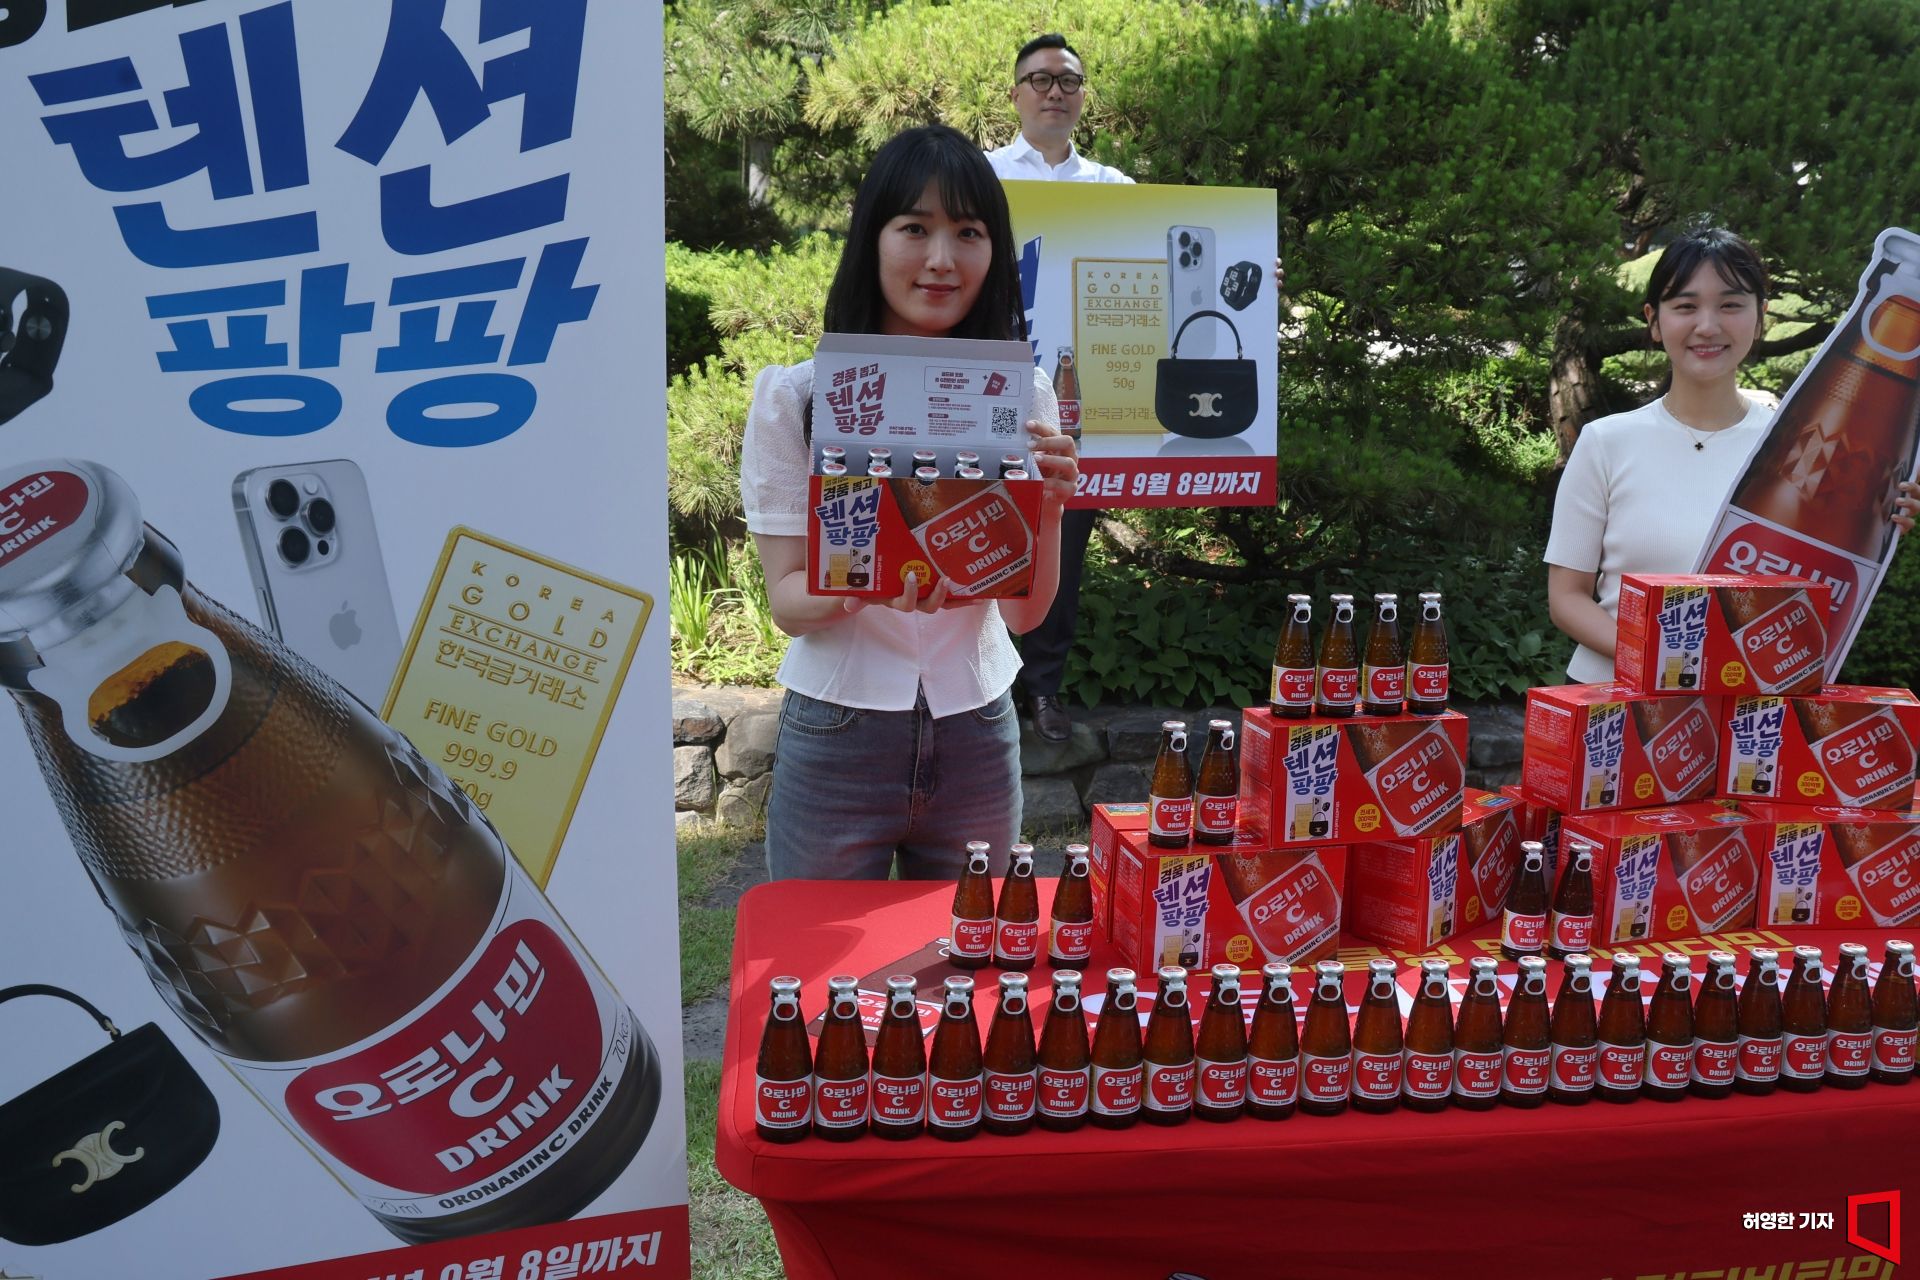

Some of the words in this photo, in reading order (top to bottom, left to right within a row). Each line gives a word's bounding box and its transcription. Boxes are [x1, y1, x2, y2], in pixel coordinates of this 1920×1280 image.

[28, 0, 588, 269] 텐션
[1087, 272, 1159, 280] KOREA
[1087, 283, 1159, 294] GOLD
[1088, 300, 1159, 309] EXCHANGE
[1086, 314, 1160, 327] 한국금거래소
[145, 236, 601, 448] 팡팡
[1091, 344, 1117, 355] FINE
[1121, 344, 1156, 356] GOLD
[832, 367, 856, 387] 경품
[1106, 361, 1142, 373] 999.9
[825, 372, 887, 414] 텐션
[1112, 377, 1135, 390] 50g
[835, 410, 885, 435] 팡팡
[824, 482, 849, 502] 경품
[1132, 472, 1171, 496] 9월
[1176, 471, 1261, 495] 8일까지
[816, 487, 880, 528] 텐션
[826, 524, 880, 547] 팡팡
[931, 500, 1006, 551] 오로나민
[0, 516, 58, 558] RINK
[968, 532, 990, 553] C
[965, 544, 1012, 575] DRINK
[472, 560, 614, 623] KOREA
[462, 584, 607, 649] GOLD
[1658, 596, 1708, 633] 텐션
[1665, 628, 1706, 650] 팡팡
[1747, 606, 1808, 653] 오로나민
[450, 612, 599, 677] EXCHANGE
[1776, 635, 1794, 654] C
[1773, 646, 1811, 675] DRINK
[435, 639, 587, 710] 한국금거래소
[1430, 679, 1439, 687] C
[424, 698, 481, 734] FINE
[487, 720, 558, 757] GOLD
[1584, 712, 1625, 752] 텐션
[1731, 706, 1784, 739] 텐션
[1290, 731, 1312, 751] 경품
[1656, 714, 1703, 764] 오로나민
[1737, 737, 1782, 757] 팡팡
[1826, 722, 1894, 766] 오로나민
[442, 740, 518, 781] 999.9
[1284, 734, 1338, 778] 텐션
[1589, 744, 1624, 768] 팡팡
[1679, 742, 1692, 762] C
[1858, 750, 1879, 769] C
[1381, 739, 1443, 793] 오로나민
[1676, 752, 1707, 782] DRINK
[1855, 762, 1898, 789] DRINK
[1293, 770, 1337, 795] 팡팡
[1412, 771, 1431, 792] C
[1410, 781, 1449, 815] DRINK
[1218, 811, 1226, 819] C
[1770, 833, 1822, 869] 텐션
[1161, 863, 1184, 884] 경품
[1616, 844, 1659, 885] 텐션
[1690, 844, 1742, 895] 오로나민
[1777, 863, 1821, 886] 팡팡
[1154, 867, 1209, 910] 텐션
[1620, 876, 1656, 901] 팡팡
[1714, 873, 1730, 893] C
[1893, 869, 1911, 888] C
[1254, 870, 1319, 924] 오로나민
[1711, 882, 1744, 914] DRINK
[1161, 902, 1208, 928] 팡팡
[1286, 902, 1305, 923] C
[960, 925, 992, 935] 오로나민
[972, 935, 981, 943] C
[1284, 912, 1325, 945] DRINK
[1017, 937, 1027, 945] C
[315, 939, 545, 1121] 오로나민
[1411, 1059, 1450, 1071] 오로나민
[1851, 1050, 1862, 1060] C
[1255, 1065, 1295, 1077] 오로나민
[1426, 1071, 1437, 1081] C
[1614, 1073, 1636, 1081] DRINK
[1621, 1063, 1632, 1073] C
[448, 1057, 514, 1118] C
[762, 1085, 806, 1099] 오로나민
[823, 1084, 865, 1099] 오로나민
[877, 1082, 920, 1095] 오로나민
[937, 1085, 978, 1098] 오로나민
[990, 1079, 1033, 1091] 오로나민
[1043, 1075, 1085, 1088] 오로나민
[1263, 1088, 1287, 1096] DRINK
[1270, 1078, 1281, 1088] C
[1419, 1082, 1443, 1090] DRINK
[778, 1099, 791, 1110] C
[839, 1098, 852, 1109] C
[892, 1096, 904, 1106] C
[952, 1098, 964, 1108] C
[1006, 1092, 1018, 1103] C
[1050, 1099, 1075, 1107] DRINK
[1057, 1089, 1070, 1099] C
[567, 1075, 612, 1135] DRINK
[771, 1110, 798, 1118] DRINK
[832, 1109, 858, 1118] DRINK
[884, 1107, 910, 1115] DRINK
[944, 1109, 971, 1118] DRINK
[998, 1103, 1024, 1111] DRINK
[435, 1064, 574, 1173] DRINK
[517, 1231, 662, 1280] 8일까지
